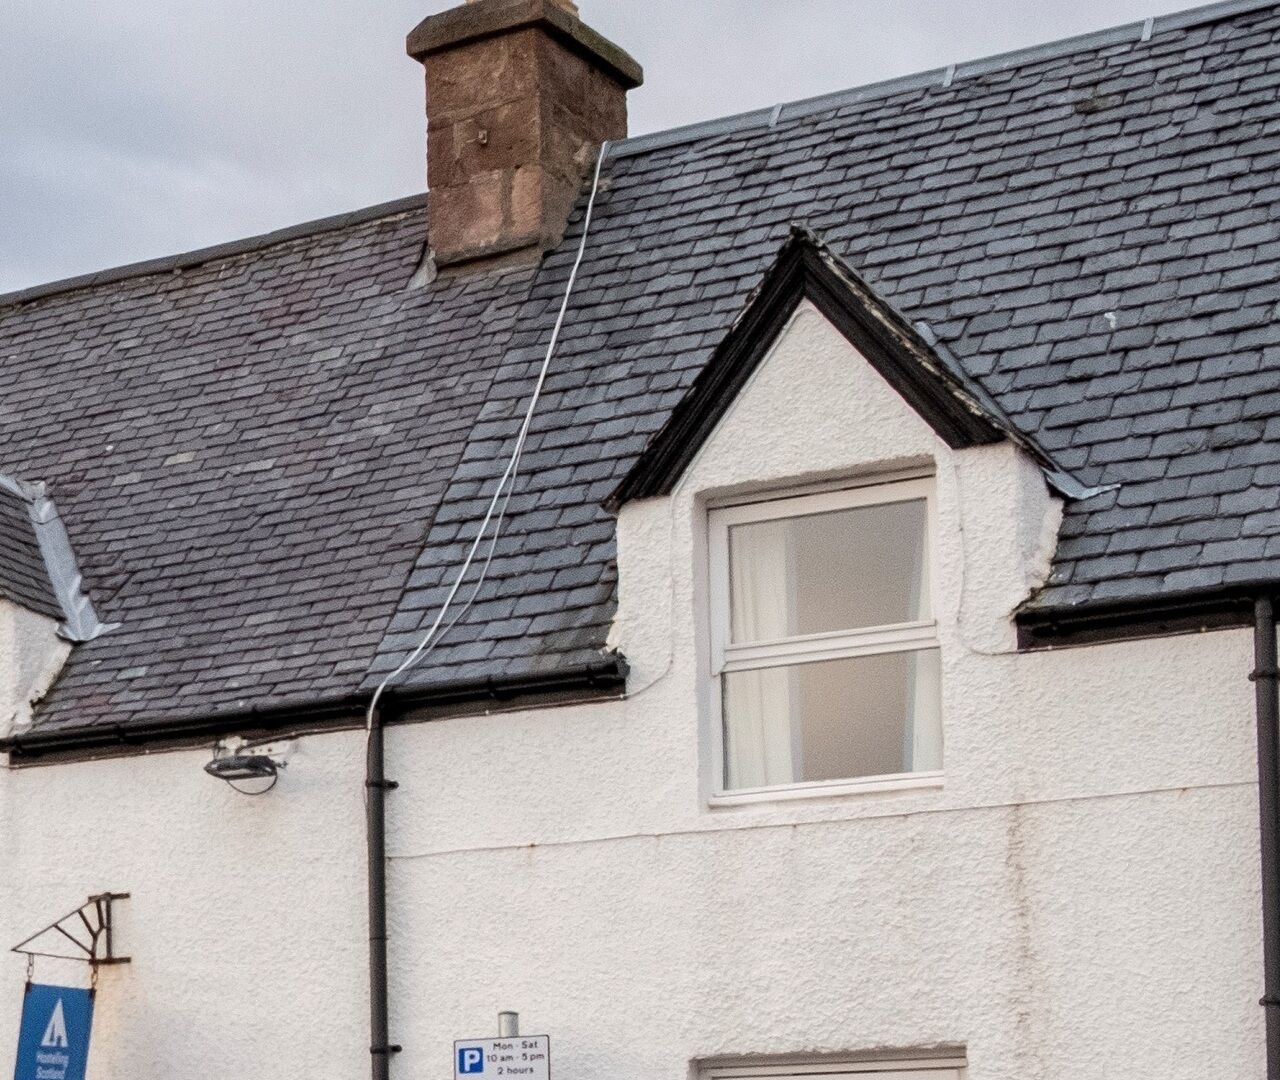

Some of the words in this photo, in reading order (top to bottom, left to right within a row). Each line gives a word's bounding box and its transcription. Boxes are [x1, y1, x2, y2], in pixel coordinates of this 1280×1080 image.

[493, 1043, 513, 1051] Mon
[522, 1041, 538, 1049] Sat
[464, 1050, 481, 1072] P
[497, 1067, 504, 1075] 2
[507, 1067, 534, 1075] hours
